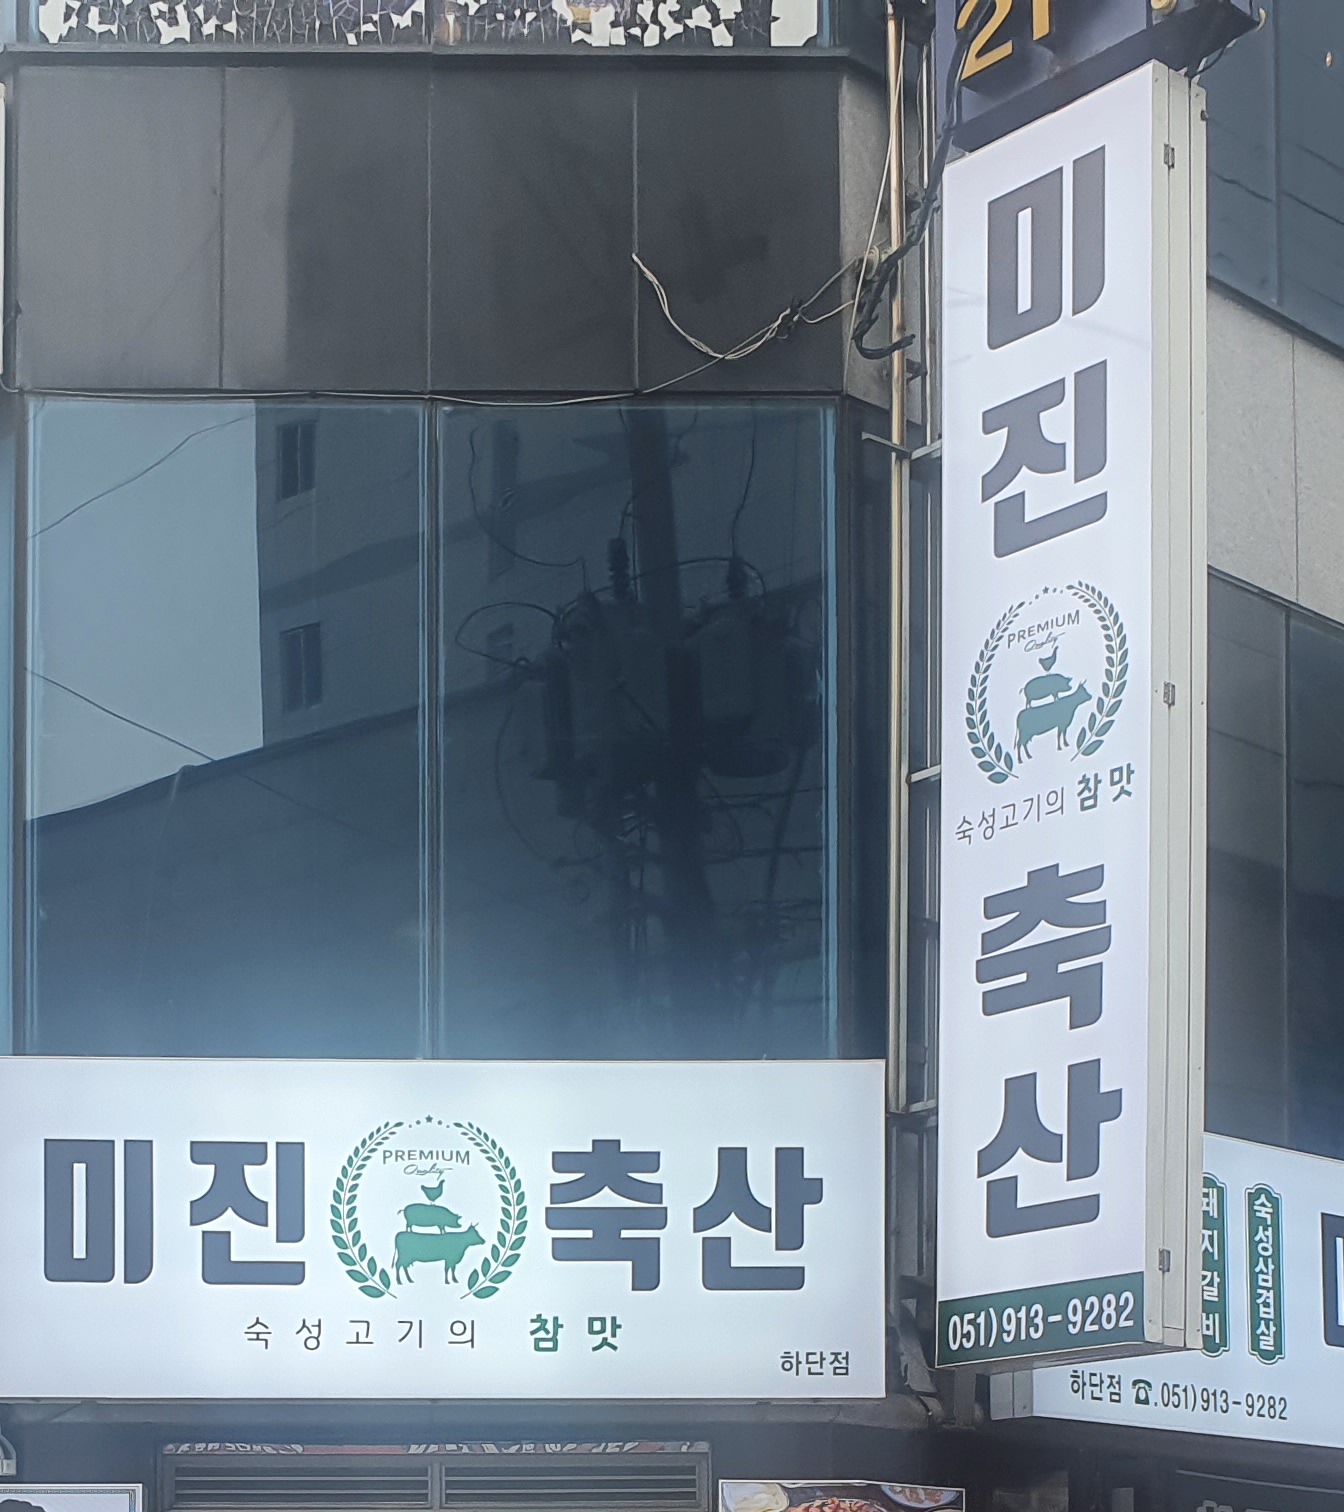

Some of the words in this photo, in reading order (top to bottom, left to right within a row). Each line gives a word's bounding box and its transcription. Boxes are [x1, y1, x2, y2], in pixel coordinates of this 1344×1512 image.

[981, 144, 1108, 559] 미진
[1007, 608, 1081, 650] PREMIUM
[954, 788, 1066, 845] 숙성고기의
[1076, 762, 1136, 813] 참맛
[975, 862, 1123, 1239] 축산
[381, 1148, 471, 1167] PREMIUM
[403, 1163, 454, 1181] Quality
[43, 1138, 306, 1286] 미진
[544, 1138, 824, 1292] 축산
[1252, 1192, 1278, 1351] 숙성삼겹살
[243, 1316, 477, 1351] 숙성고기의
[528, 1313, 623, 1352] 참맛
[947, 1289, 1136, 1350] 051)913-9282
[779, 1349, 852, 1378] 하단점
[1069, 1368, 1123, 1404] 하단점
